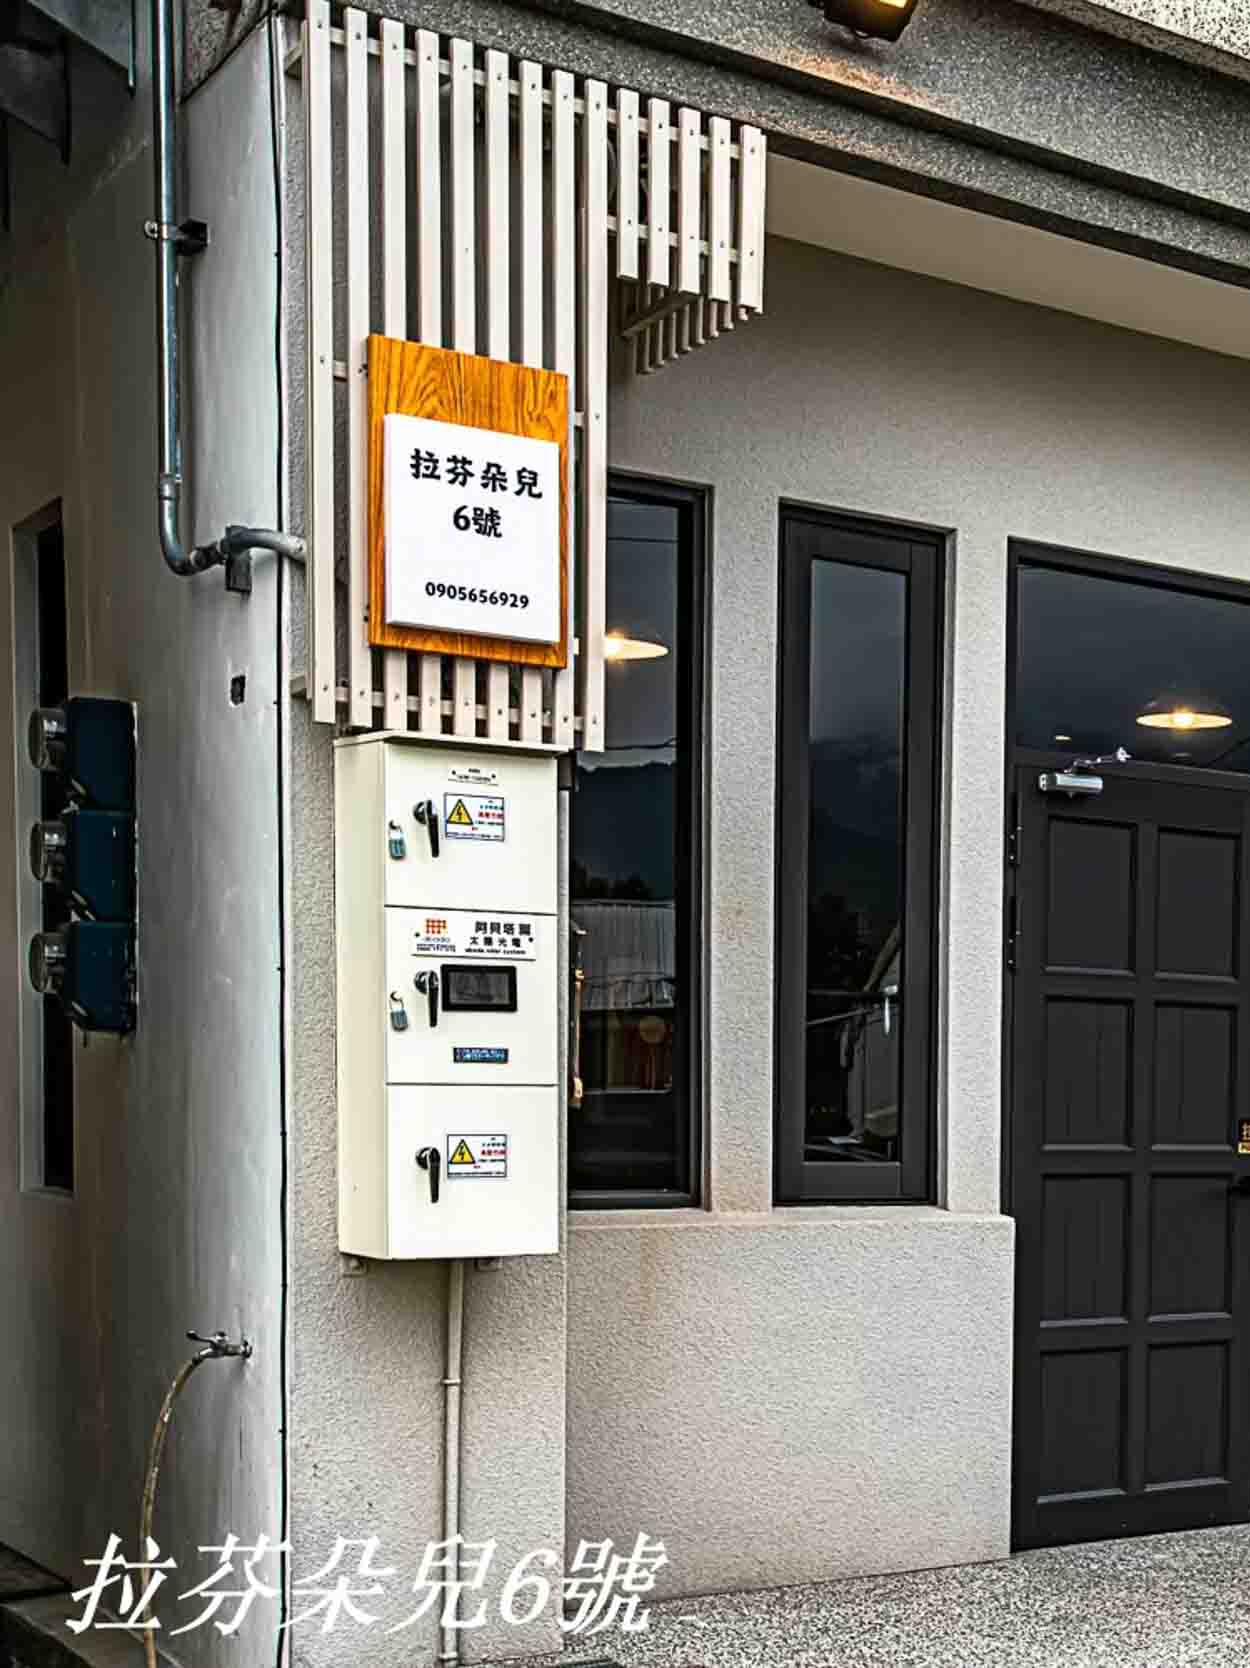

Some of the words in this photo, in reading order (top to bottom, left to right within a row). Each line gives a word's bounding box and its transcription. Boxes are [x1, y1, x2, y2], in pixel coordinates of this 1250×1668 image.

[410, 448, 543, 499] 拉芬朵兒
[453, 505, 503, 538] 6號
[425, 581, 529, 609] 0905656929
